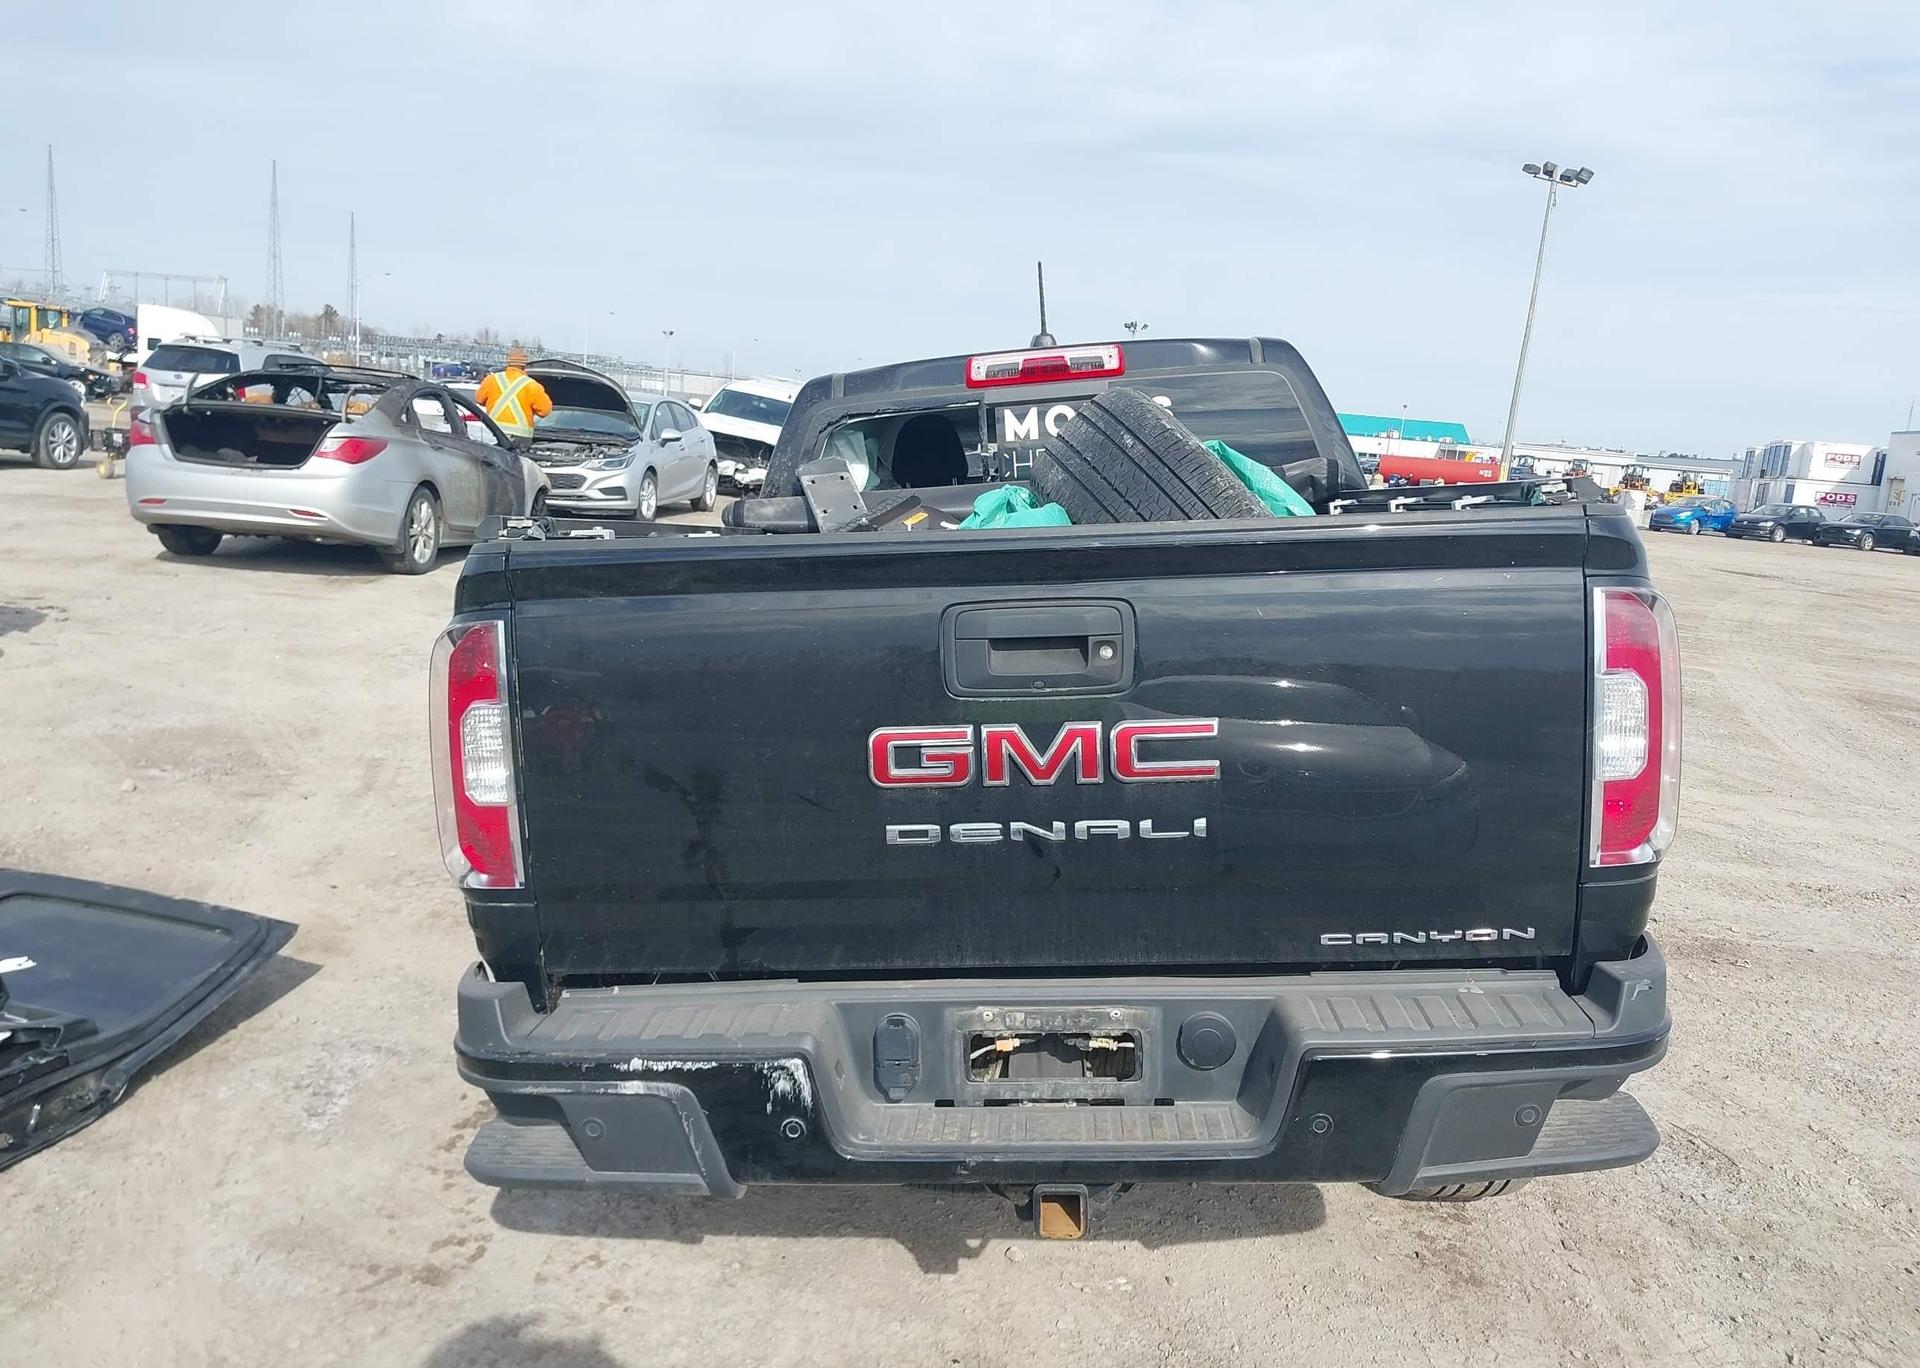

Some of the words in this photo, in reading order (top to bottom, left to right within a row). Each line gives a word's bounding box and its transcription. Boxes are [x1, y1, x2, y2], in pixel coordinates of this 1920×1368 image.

[1826, 454, 1860, 462] PODS
[1816, 493, 1856, 502] PODS
[867, 717, 1221, 788] GMC
[885, 817, 1208, 845] DENALI
[1320, 926, 1536, 947] CANYON
